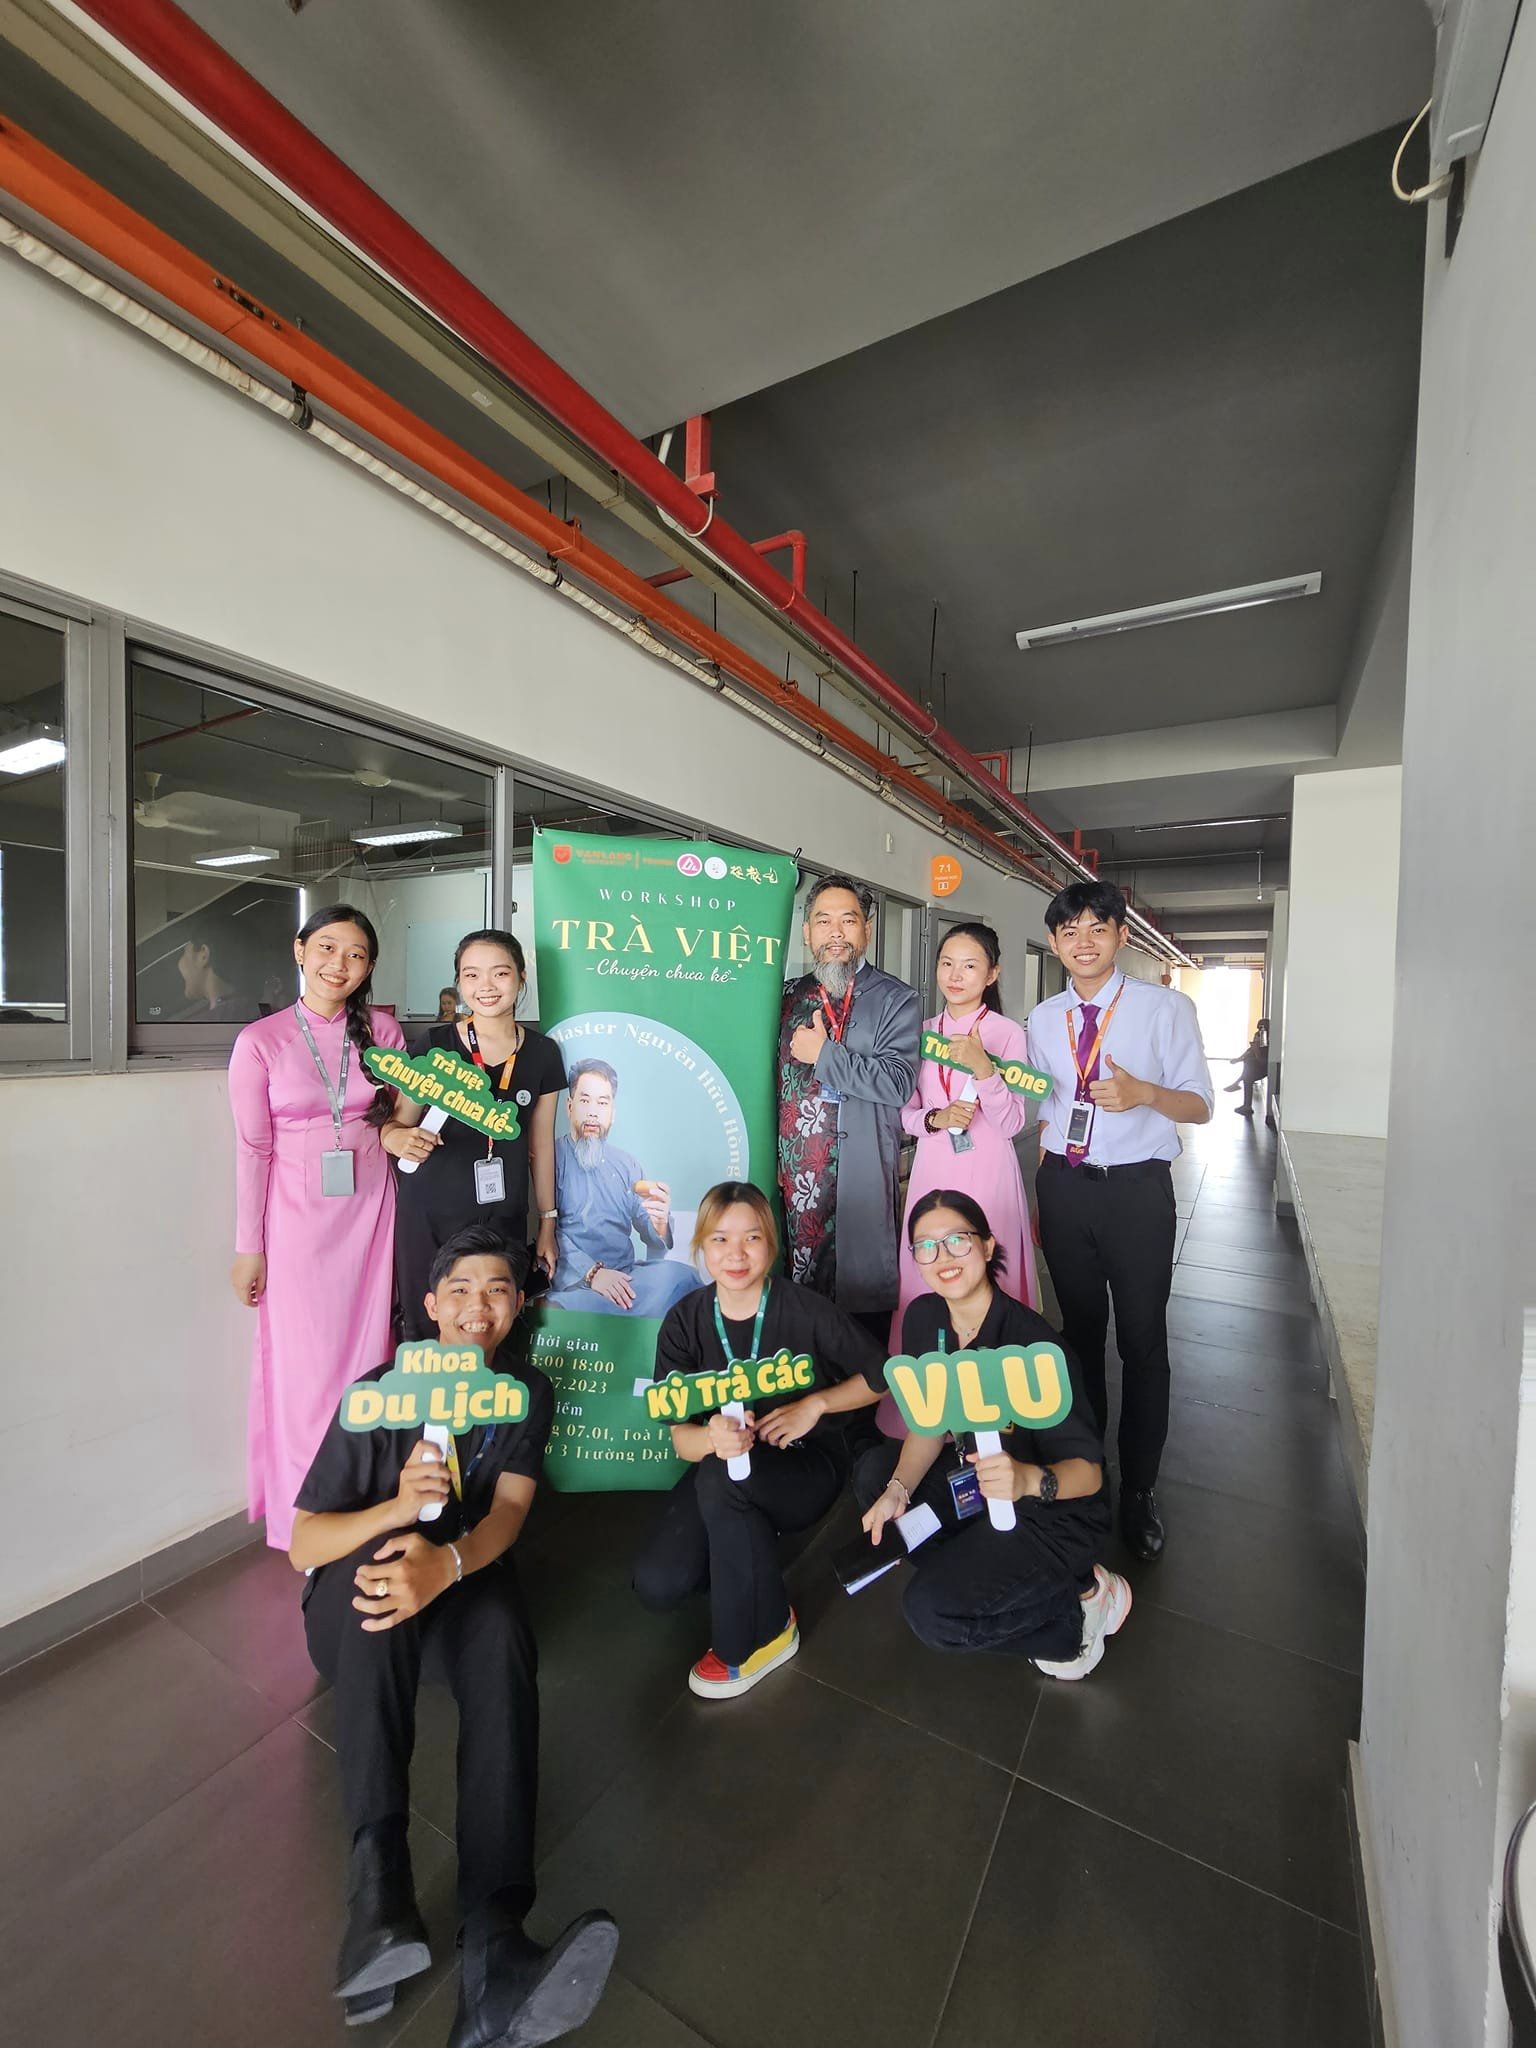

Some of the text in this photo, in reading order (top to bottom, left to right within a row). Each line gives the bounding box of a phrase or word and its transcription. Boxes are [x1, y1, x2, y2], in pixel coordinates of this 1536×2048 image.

[600, 888, 736, 911] WORKSHOP
[552, 914, 781, 969] TRÀ VIỆT
[432, 1052, 456, 1075] Trà
[371, 1053, 444, 1100] -Chuyện
[443, 1089, 481, 1122] chưa
[566, 1338, 599, 1352] gian
[402, 1347, 477, 1374] Khoa
[572, 1358, 614, 1374] 18:00
[549, 1375, 607, 1394] 7.2023
[647, 1354, 811, 1419] Kỳ Trà Các
[892, 1353, 1062, 1428] VLU
[347, 1381, 522, 1428] Du Lịch
